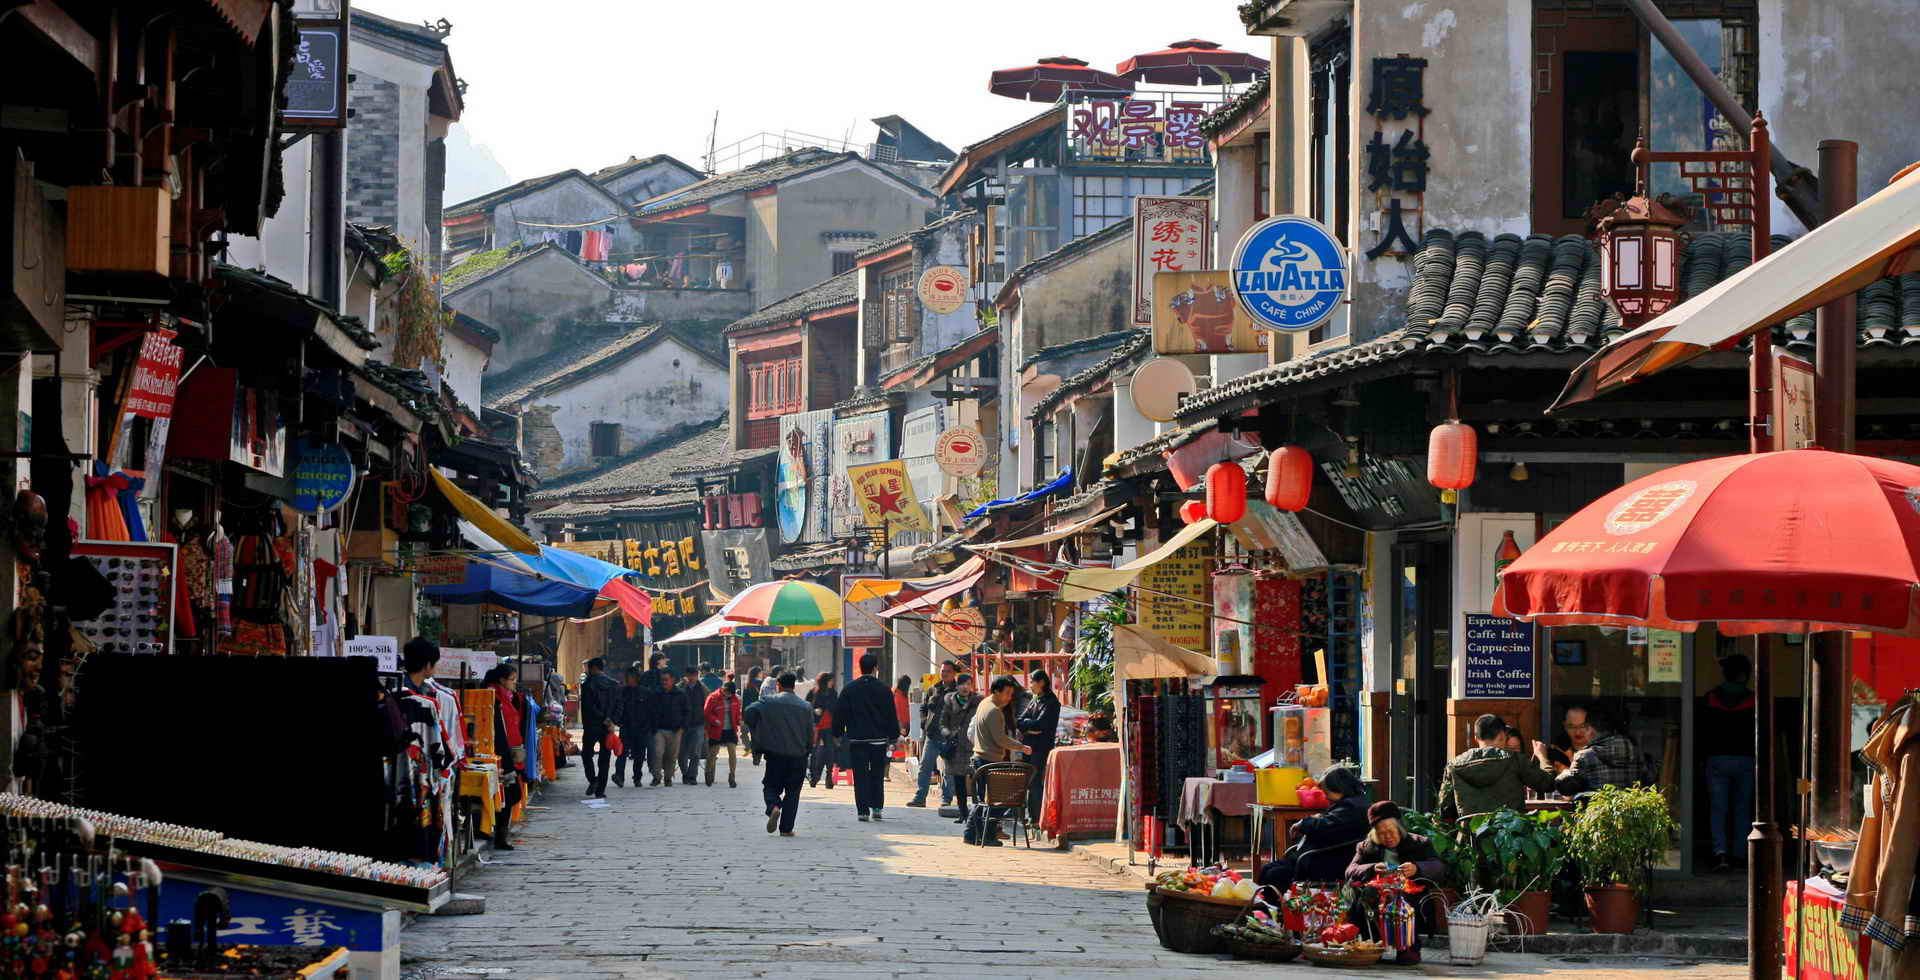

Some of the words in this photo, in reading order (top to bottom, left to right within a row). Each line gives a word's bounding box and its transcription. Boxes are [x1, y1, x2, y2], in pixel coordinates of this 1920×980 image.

[1366, 54, 1431, 261] 原始人
[1151, 220, 1184, 271] 绣花
[1239, 263, 1345, 291] LAVAZZA
[1261, 301, 1287, 320] CAFÉ
[1295, 300, 1326, 320] CHINA
[624, 535, 700, 578] 骑士酒吧
[1468, 616, 1512, 627] Espresso
[1501, 630, 1525, 639] latte
[375, 643, 393, 655] Silk
[1467, 642, 1531, 654] Cappuccino
[1467, 656, 1503, 666] Mocha
[1467, 669, 1492, 679] Irish
[1496, 669, 1532, 679] Coffee
